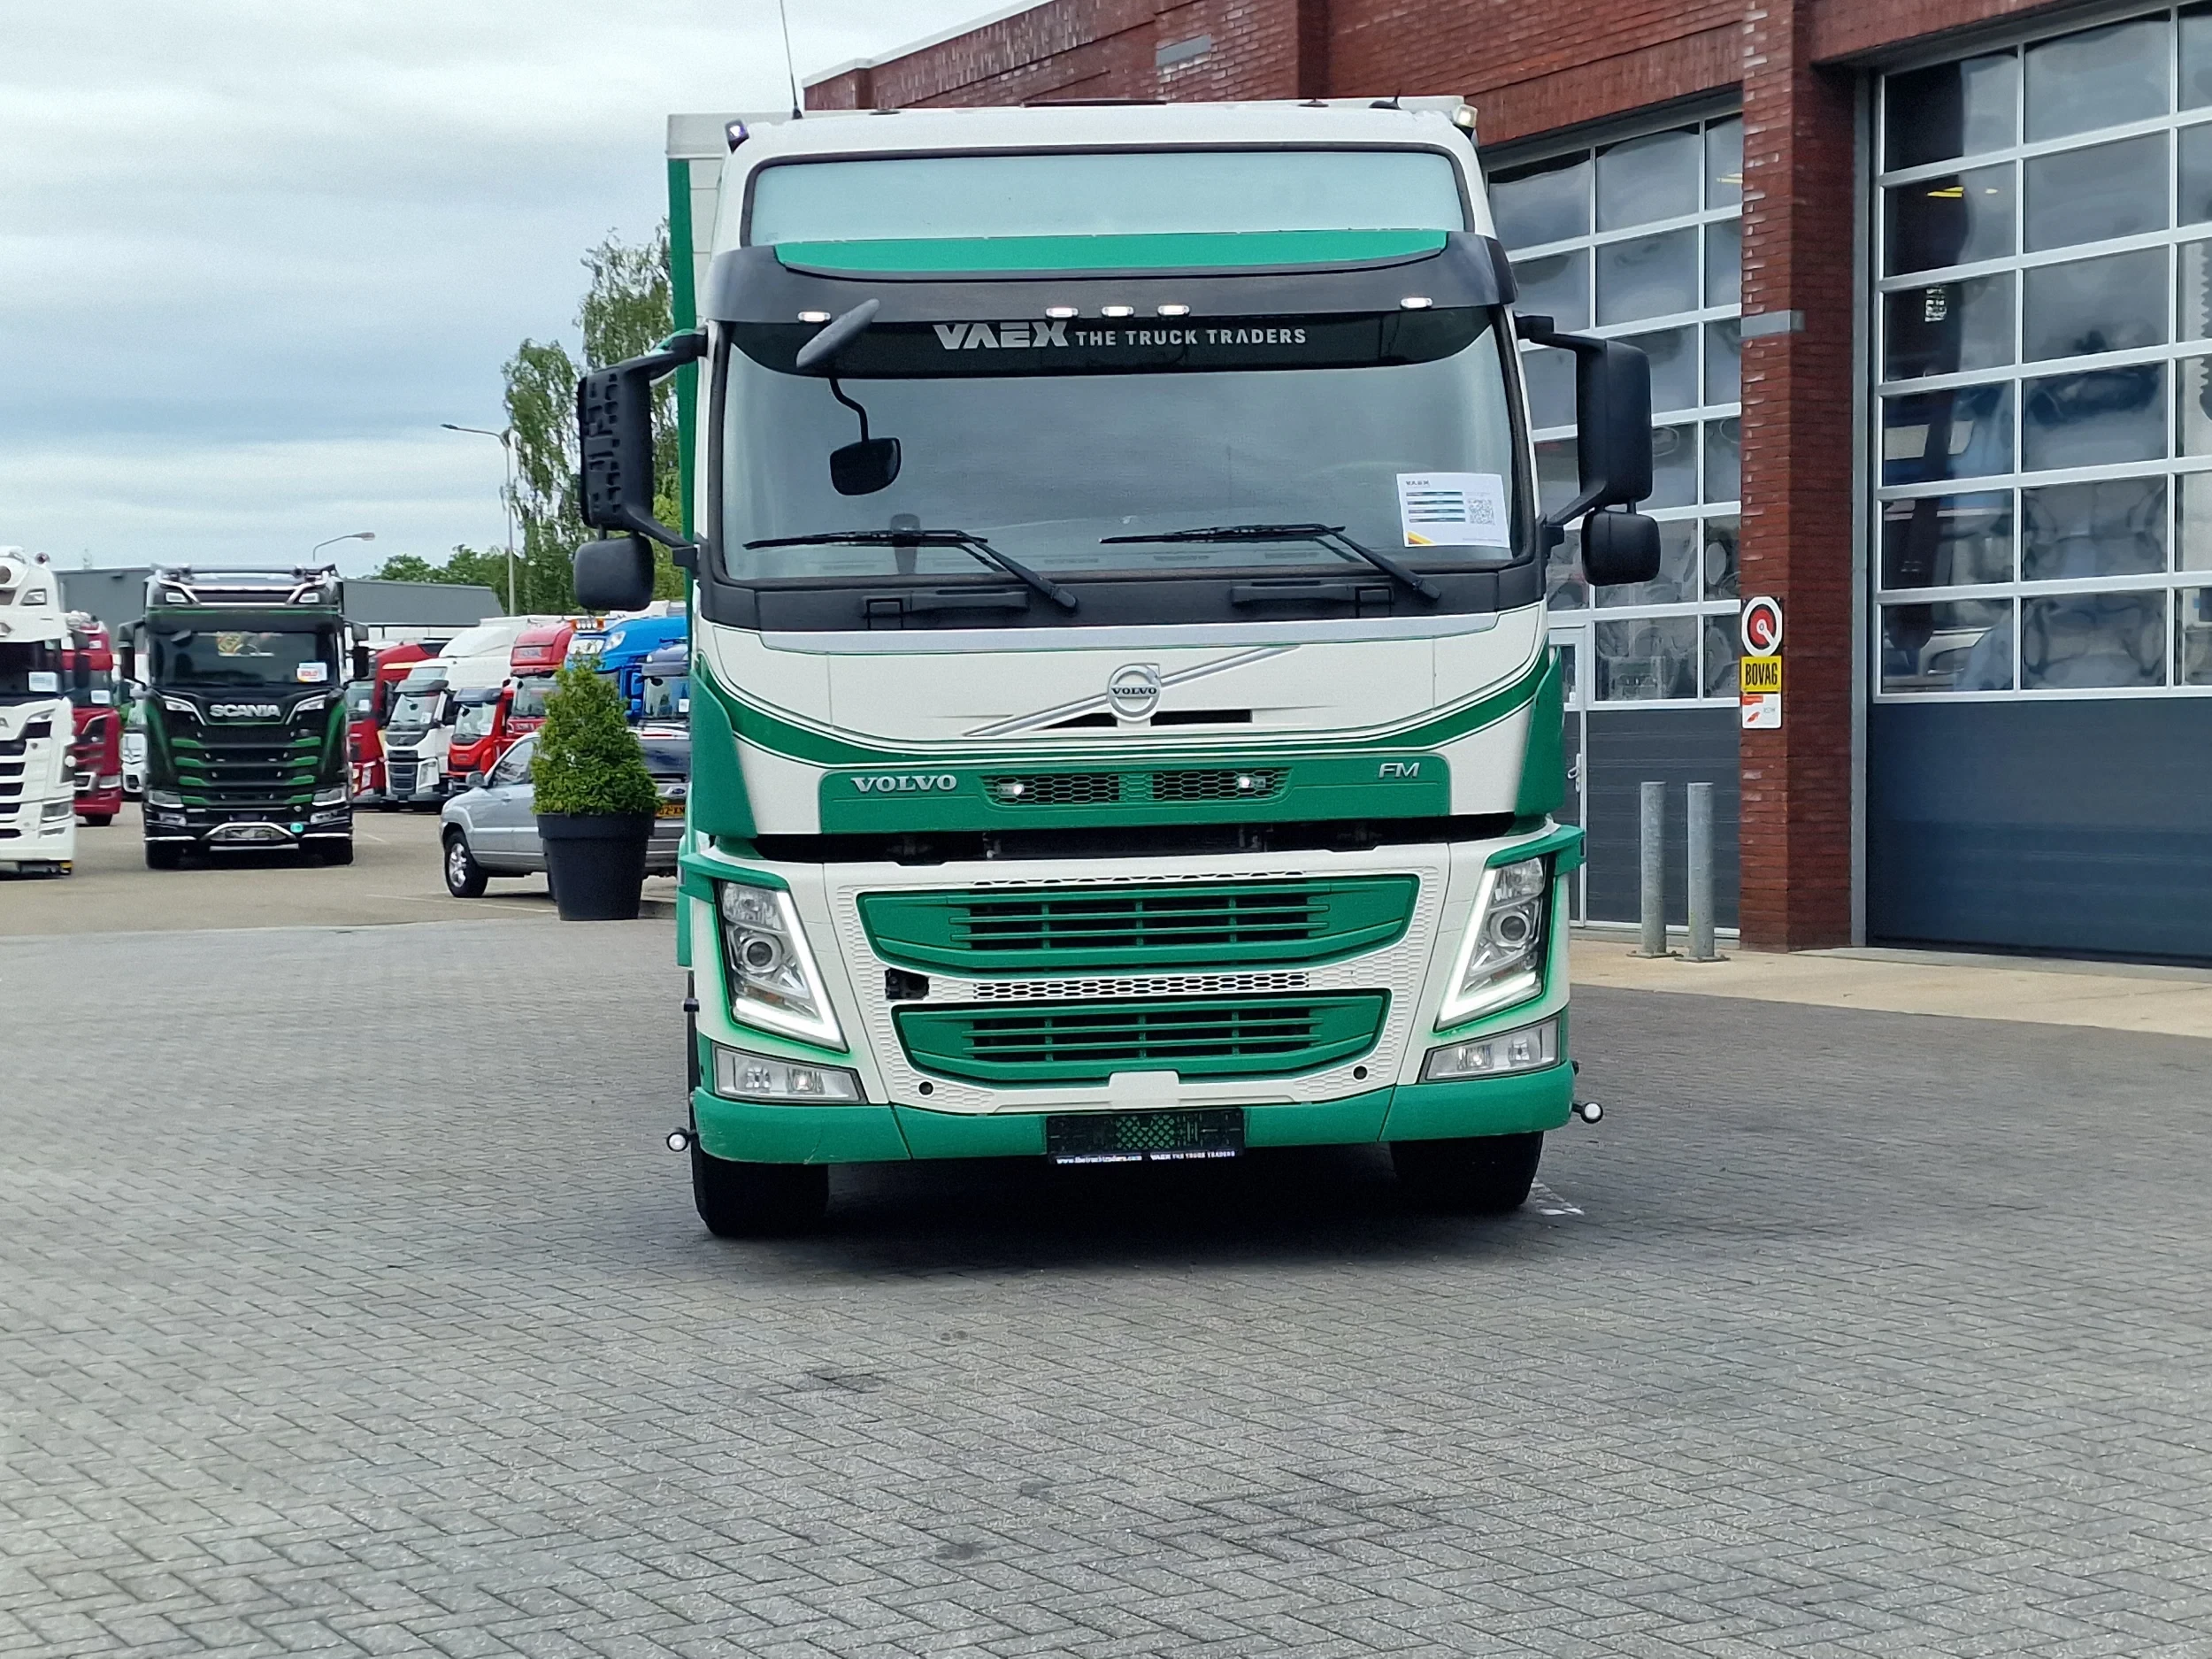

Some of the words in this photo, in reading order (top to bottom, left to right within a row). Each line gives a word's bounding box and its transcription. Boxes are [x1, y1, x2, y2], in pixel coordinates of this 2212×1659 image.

[933, 321, 1069, 349] VAEX
[1076, 330, 1117, 346] THE
[1125, 329, 1198, 345] TRUCK
[1206, 328, 1307, 344] TRADERS
[1745, 662, 1778, 686] BOVAG
[1111, 687, 1156, 696] VOLVO
[210, 704, 280, 718] SCANIA
[1379, 762, 1419, 779] FM
[850, 775, 956, 793] VOLVO
